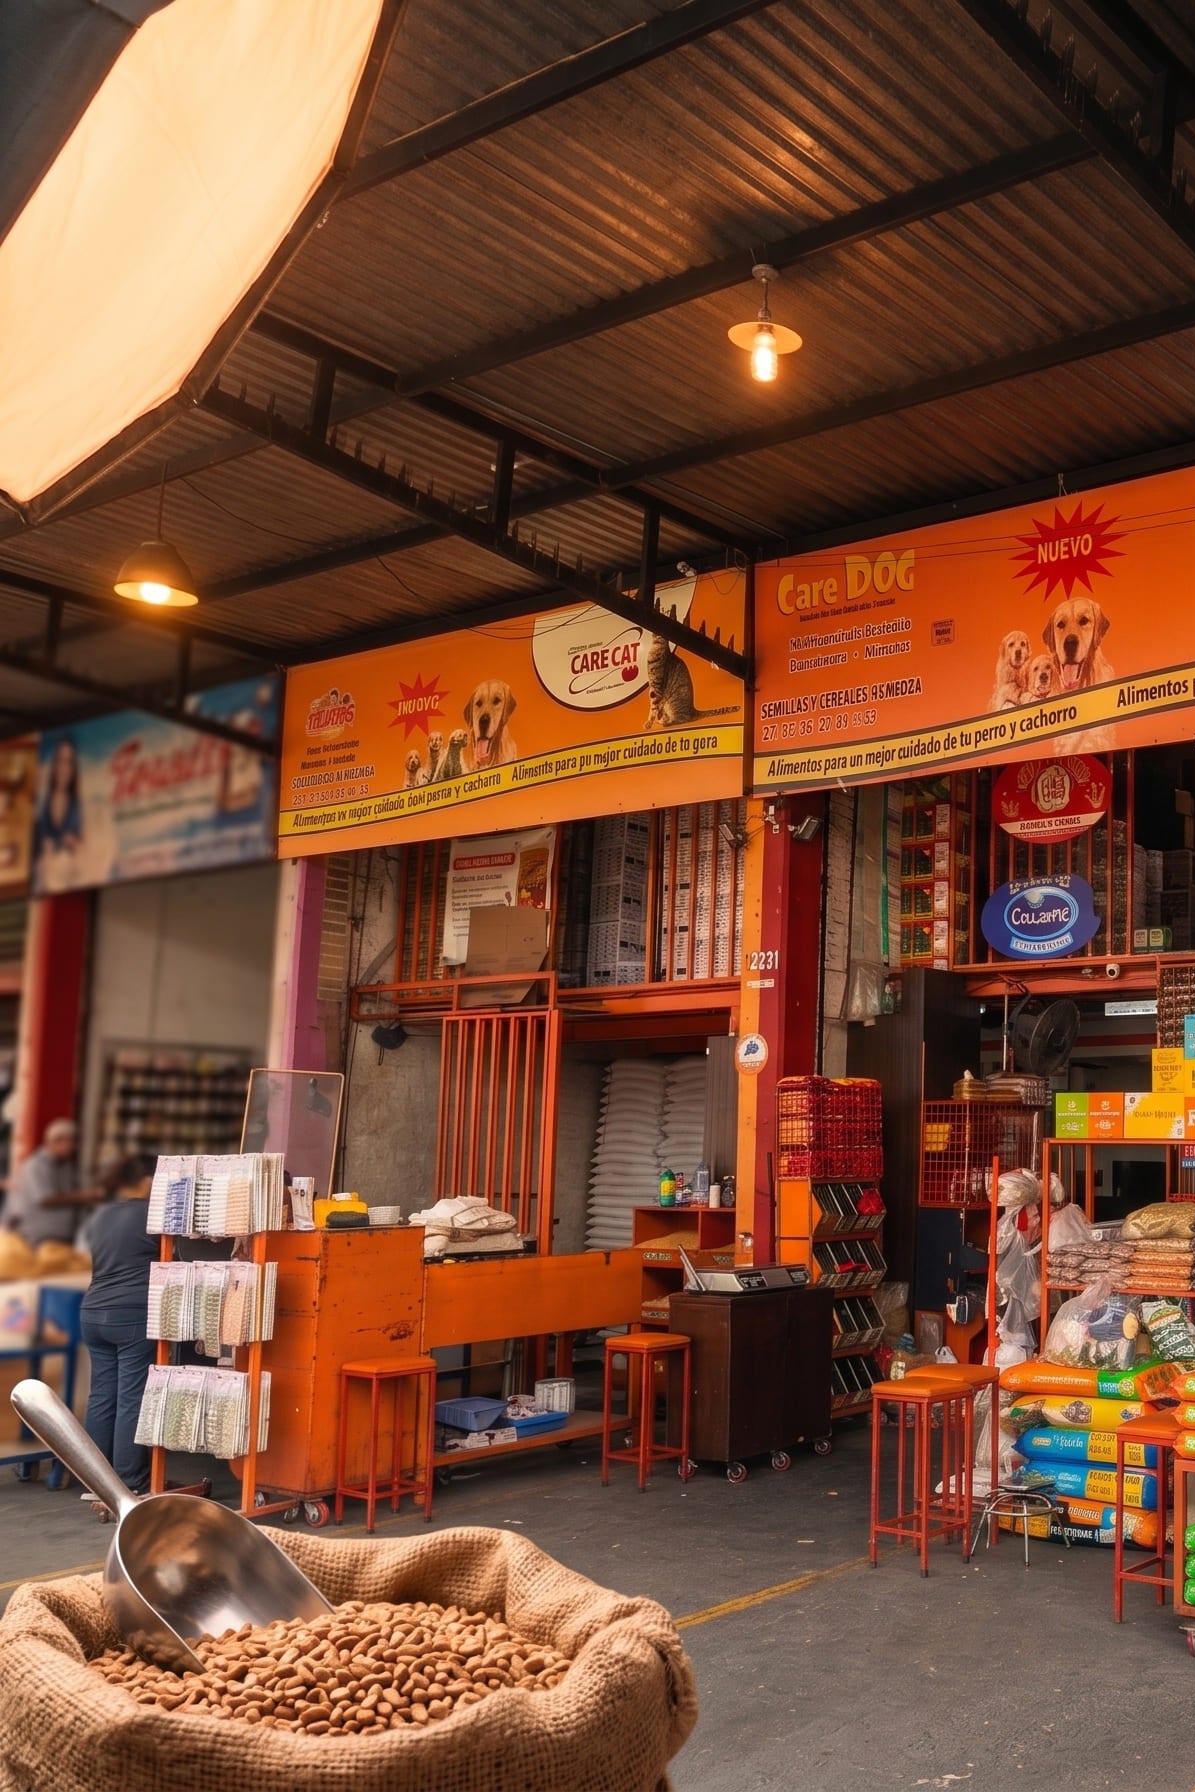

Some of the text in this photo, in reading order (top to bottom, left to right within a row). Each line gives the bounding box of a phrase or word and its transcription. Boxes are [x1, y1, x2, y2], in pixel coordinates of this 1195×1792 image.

[1037, 533, 1093, 564] NUEVO
[776, 574, 838, 615] Care
[844, 549, 915, 600] DOG
[571, 648, 609, 675] CARE
[611, 642, 640, 667] CAT
[761, 695, 809, 720] SEMILLAS
[810, 694, 818, 711] Y
[820, 686, 868, 710] CEREALES
[768, 759, 822, 777] Alimentos
[824, 756, 847, 775] para
[850, 755, 863, 768] un
[865, 745, 896, 767] mejor
[898, 736, 941, 760] cuidado
[943, 733, 957, 750] de
[960, 731, 971, 746] tu
[974, 724, 1006, 748] perro
[1010, 721, 1017, 739] y
[1020, 706, 1077, 732] cachorro
[1116, 678, 1189, 708] Alimentos
[623, 739, 663, 760] cuidado
[665, 736, 677, 753] de
[750, 950, 778, 970] 2231
